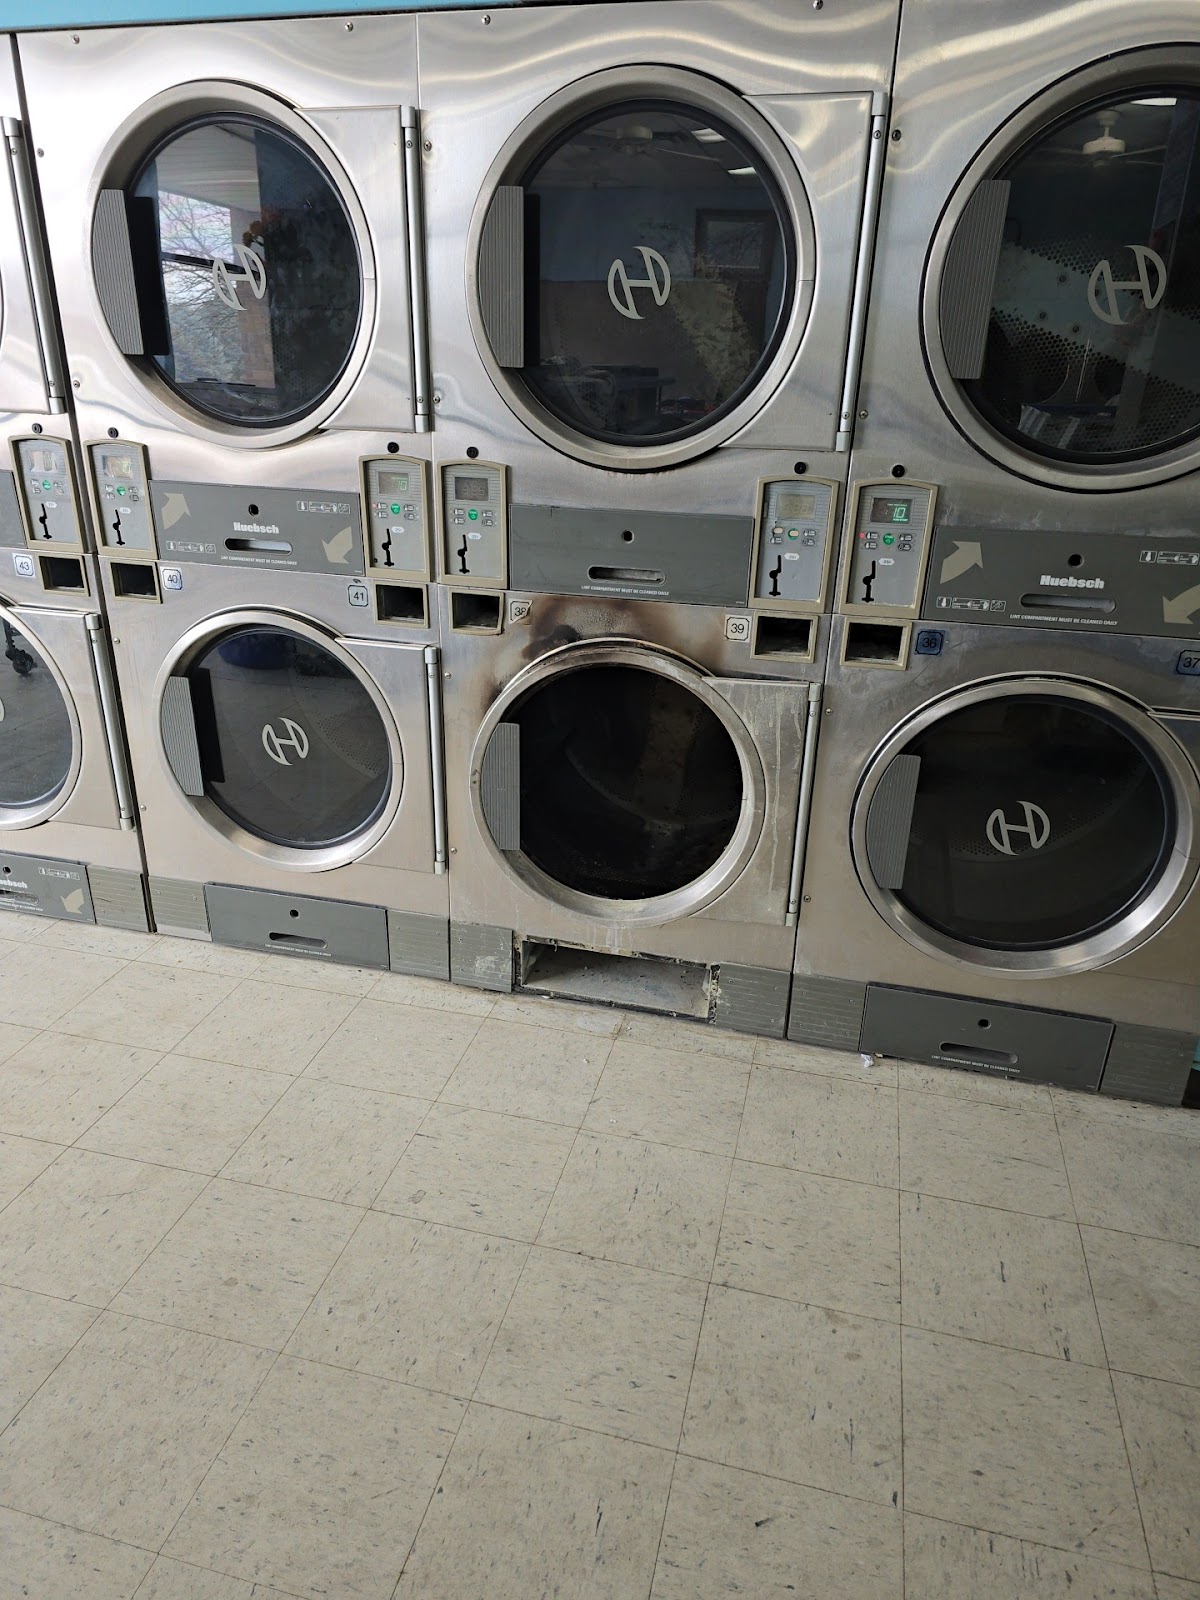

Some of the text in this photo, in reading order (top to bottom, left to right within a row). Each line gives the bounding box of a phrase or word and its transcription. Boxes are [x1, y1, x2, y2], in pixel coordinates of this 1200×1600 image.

[233, 521, 280, 534] Huebsch
[19, 561, 30, 571] 43
[167, 574, 179, 584] 40
[1039, 574, 1105, 589] Huebsch
[353, 591, 365, 602] 41
[730, 623, 745, 634] 39
[922, 637, 937, 648] 36
[1182, 656, 1200, 668] 37
